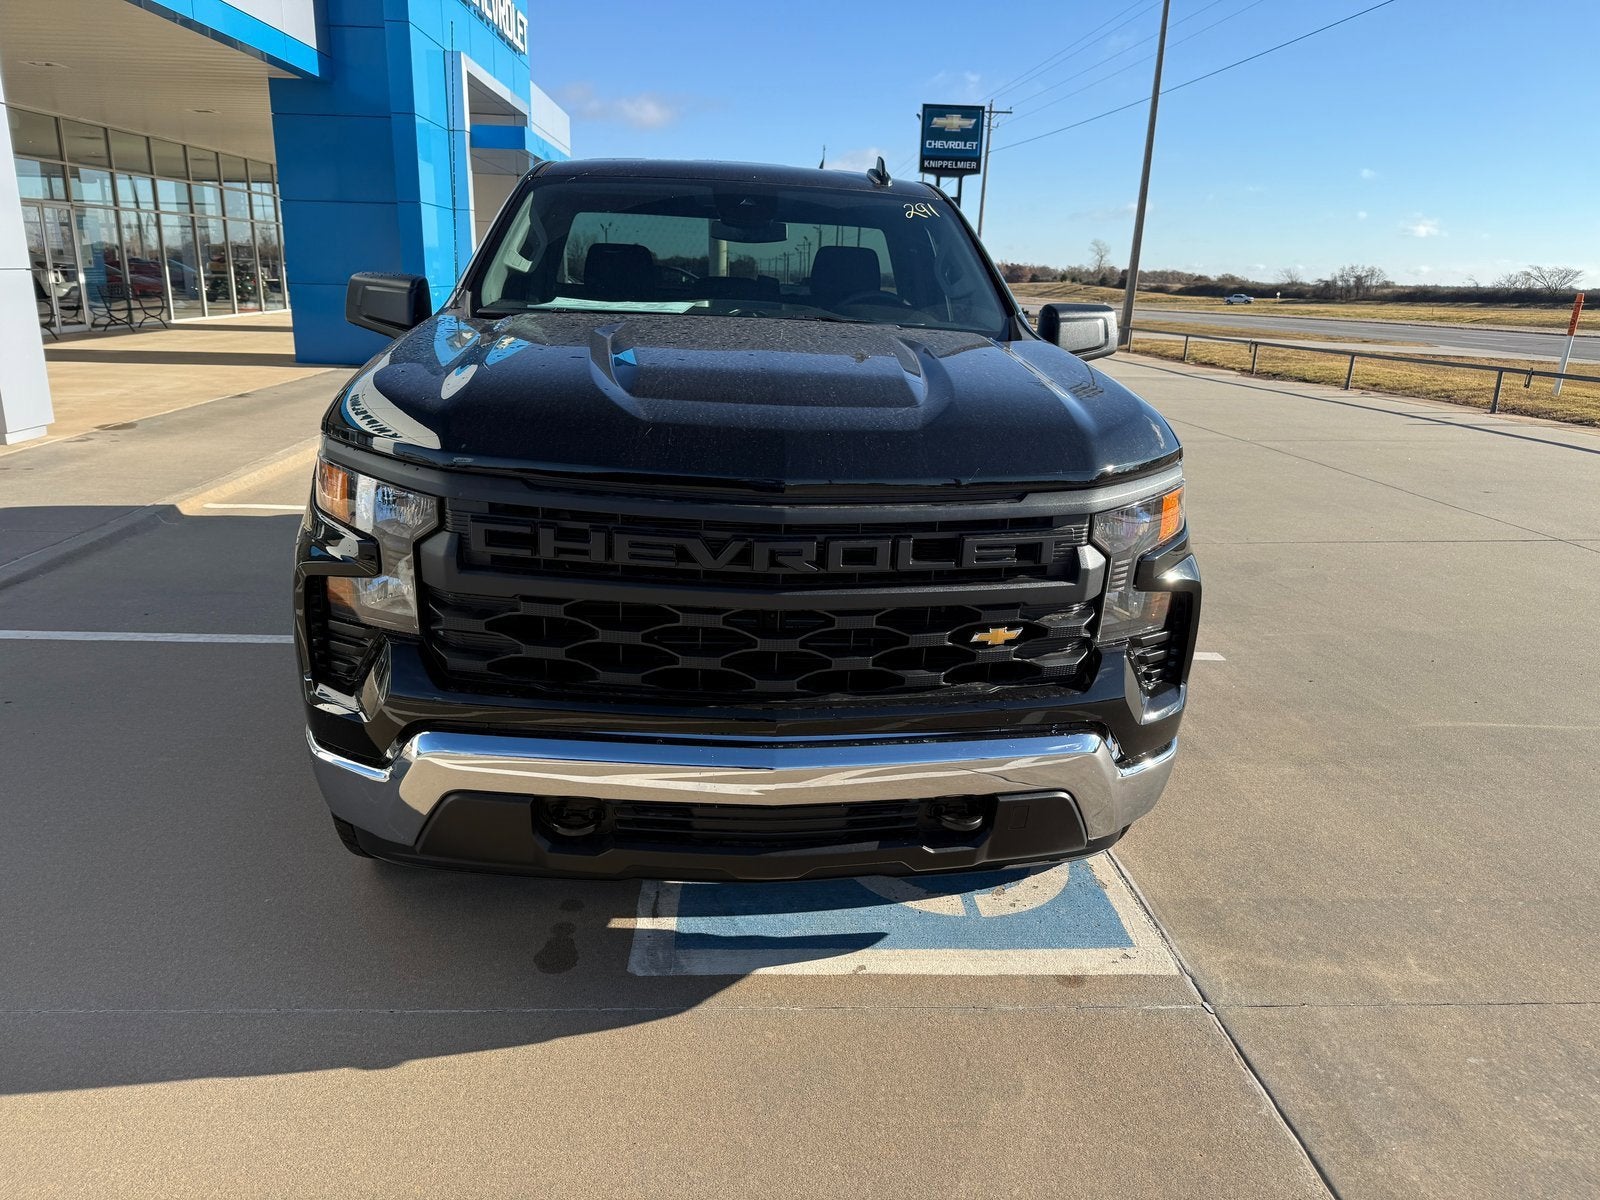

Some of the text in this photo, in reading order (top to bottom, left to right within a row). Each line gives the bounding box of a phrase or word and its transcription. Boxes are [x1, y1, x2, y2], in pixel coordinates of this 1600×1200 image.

[926, 140, 978, 150] CHEVROLET
[924, 160, 977, 169] KNIPPELMIER
[903, 202, 941, 219] 291
[470, 515, 1075, 573] CHEVROLET
